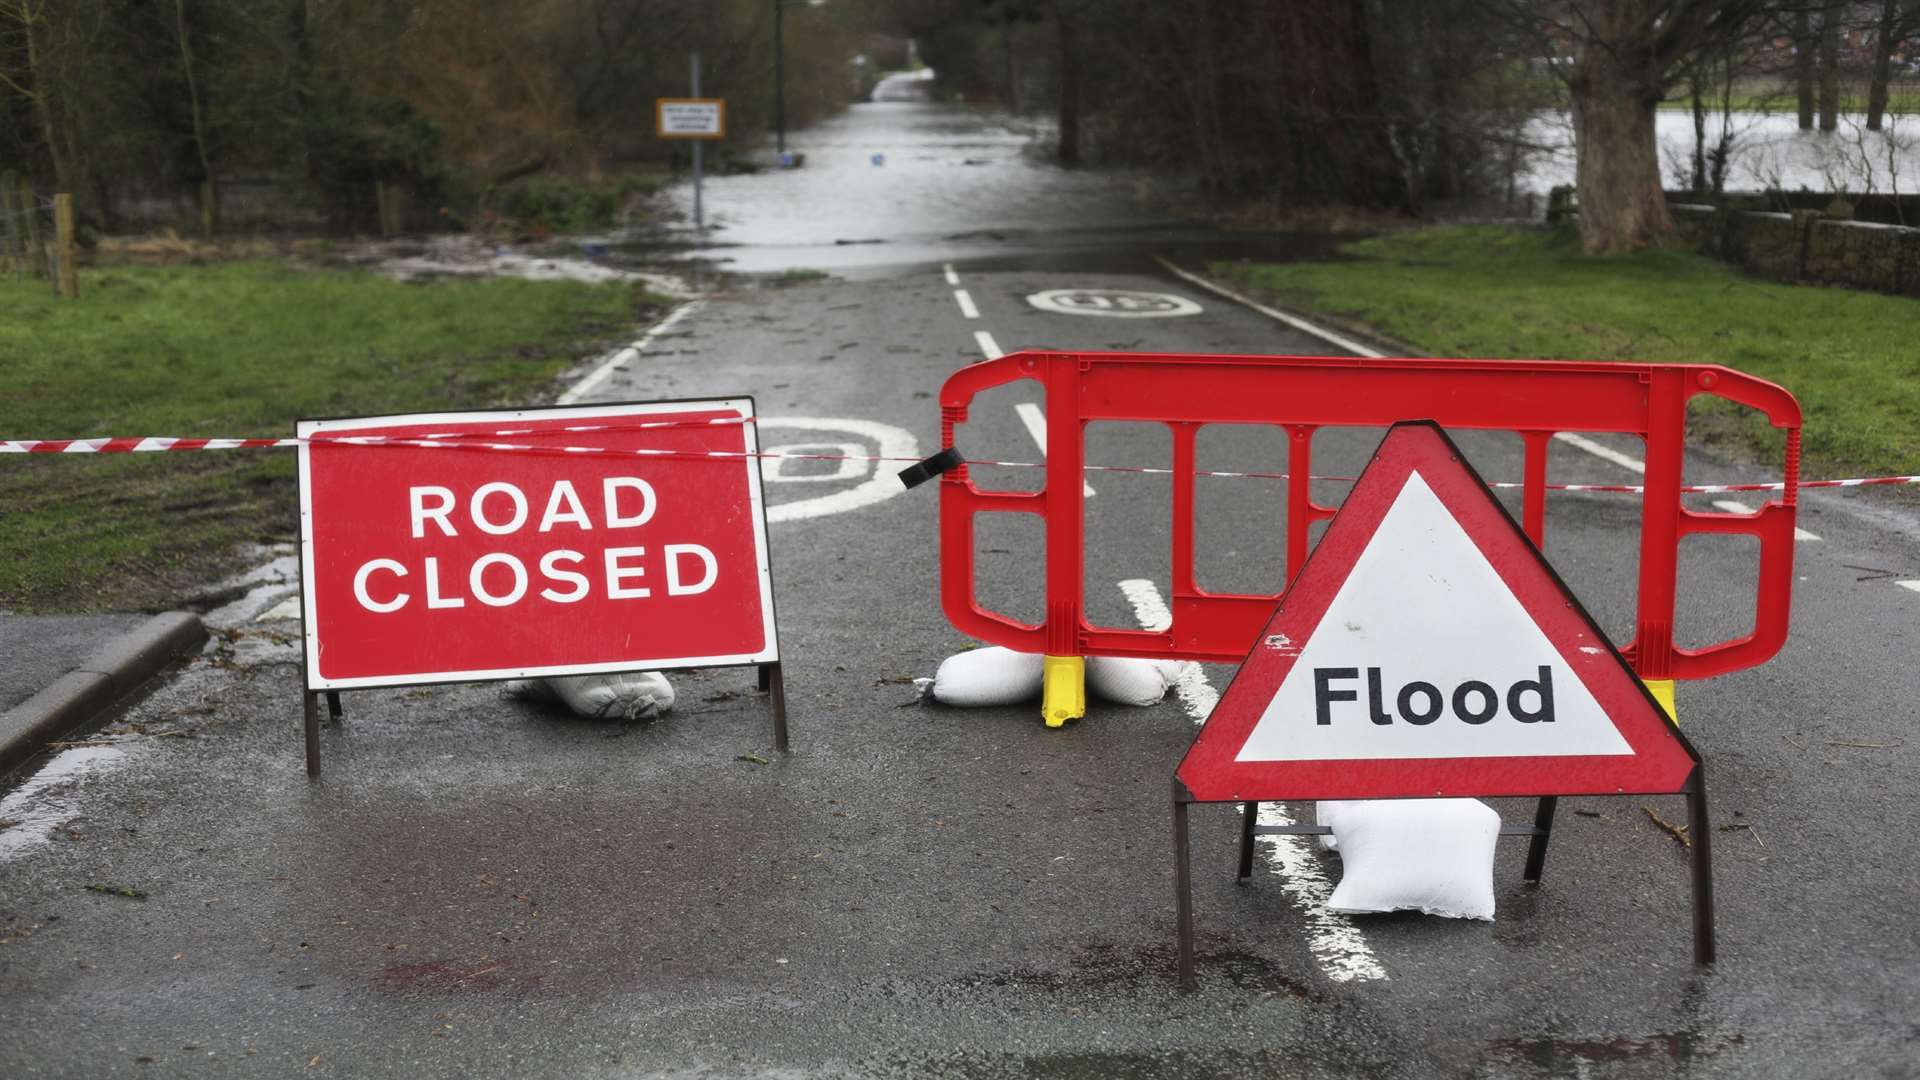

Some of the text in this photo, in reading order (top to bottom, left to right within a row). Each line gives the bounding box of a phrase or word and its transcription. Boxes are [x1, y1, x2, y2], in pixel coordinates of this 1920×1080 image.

[409, 476, 657, 538] ROAD
[353, 543, 719, 613] CLOSED
[1313, 665, 1555, 726] Flood
